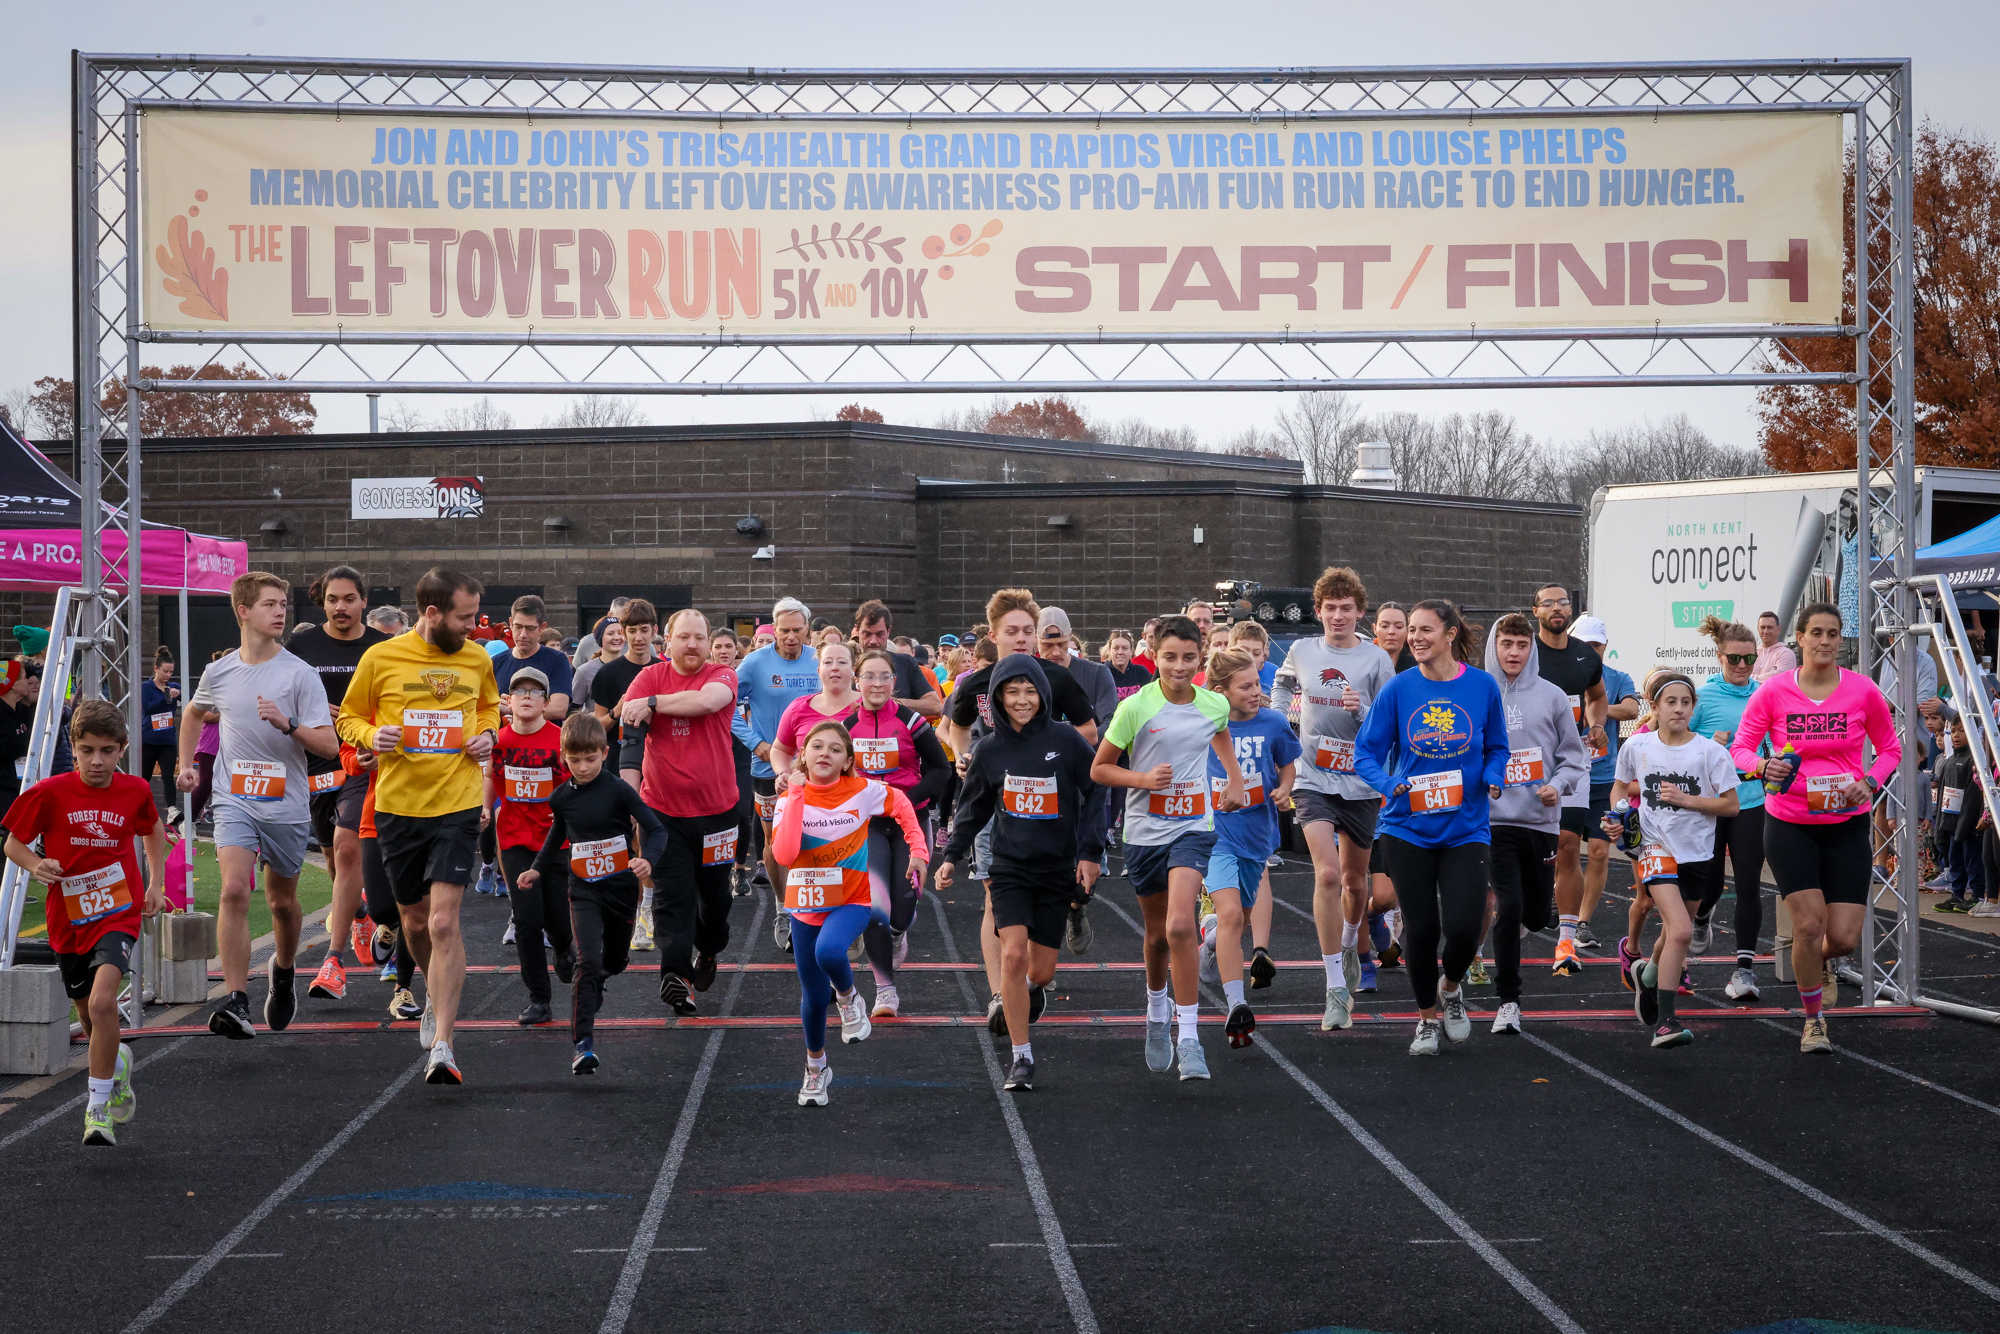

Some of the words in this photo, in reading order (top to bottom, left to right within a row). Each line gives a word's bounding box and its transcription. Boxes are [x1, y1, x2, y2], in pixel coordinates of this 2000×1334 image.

[371, 127, 437, 164] JON
[445, 129, 519, 166] AND
[527, 130, 651, 167] JOHN'S
[657, 131, 890, 168] TRIS4HEALTH
[900, 133, 1021, 169] GRAND
[1030, 133, 1160, 168] RAPIDS
[1167, 133, 1285, 168] VIRGIL
[1292, 131, 1363, 167] AND
[1372, 130, 1492, 166] LOUISE
[1499, 127, 1627, 164] PHELPS
[250, 169, 439, 209] MEMORIAL
[447, 170, 636, 210] CELEBRITY
[645, 172, 836, 211] LEFTOVERS
[844, 173, 1061, 211] AWARENESS
[1069, 172, 1209, 210] PRO-AM
[1218, 172, 1284, 209] FUN
[1293, 171, 1365, 209] RUN
[1374, 170, 1463, 209] RACE
[1471, 169, 1515, 208] TO
[1525, 169, 1590, 207] END
[1599, 168, 1744, 206] HUNGER.
[228, 225, 283, 262] THE
[290, 225, 621, 320] LEFTOVER
[628, 228, 761, 321] RUN
[773, 268, 821, 320] 5K
[825, 283, 857, 307] AND
[860, 267, 928, 319] 10K
[359, 487, 471, 509] CONCESSIONS
[1668, 523, 1706, 536] NORTH
[1713, 521, 1742, 534] KENT
[11, 541, 26, 560] A
[33, 543, 81, 564] PRO.
[1652, 532, 1757, 584] connect
[1948, 567, 1995, 585] PREMIER
[1656, 647, 1699, 660] Gently-loved
[1696, 663, 1706, 674] for
[785, 679, 805, 687] TURKEY
[418, 728, 448, 747] 627
[672, 727, 690, 735] LIVES
[1413, 731, 1440, 742] Autumn
[1441, 731, 1467, 742] Classic
[862, 753, 886, 769] 646
[315, 772, 334, 789] 639
[1014, 778, 1036, 786] LEFTOVER
[1506, 763, 1532, 783] 683
[244, 776, 271, 795] 677
[515, 781, 539, 798] 647
[1015, 793, 1044, 813] 642
[1164, 796, 1193, 815] 643
[1424, 788, 1450, 809] 641
[67, 810, 99, 824] FOREST
[101, 811, 125, 827] HILLS
[802, 819, 828, 828] World
[829, 816, 853, 826] Vision
[70, 837, 89, 846] CROSS
[91, 838, 119, 847] COUNTRY
[581, 843, 603, 852] LEFTOVER
[714, 843, 734, 861] 645
[586, 855, 615, 877] 626
[1641, 857, 1663, 878] 734
[72, 874, 98, 887] LEFTOVER
[86, 882, 98, 891] 5K
[79, 887, 115, 915] 625
[797, 886, 825, 907] 613
